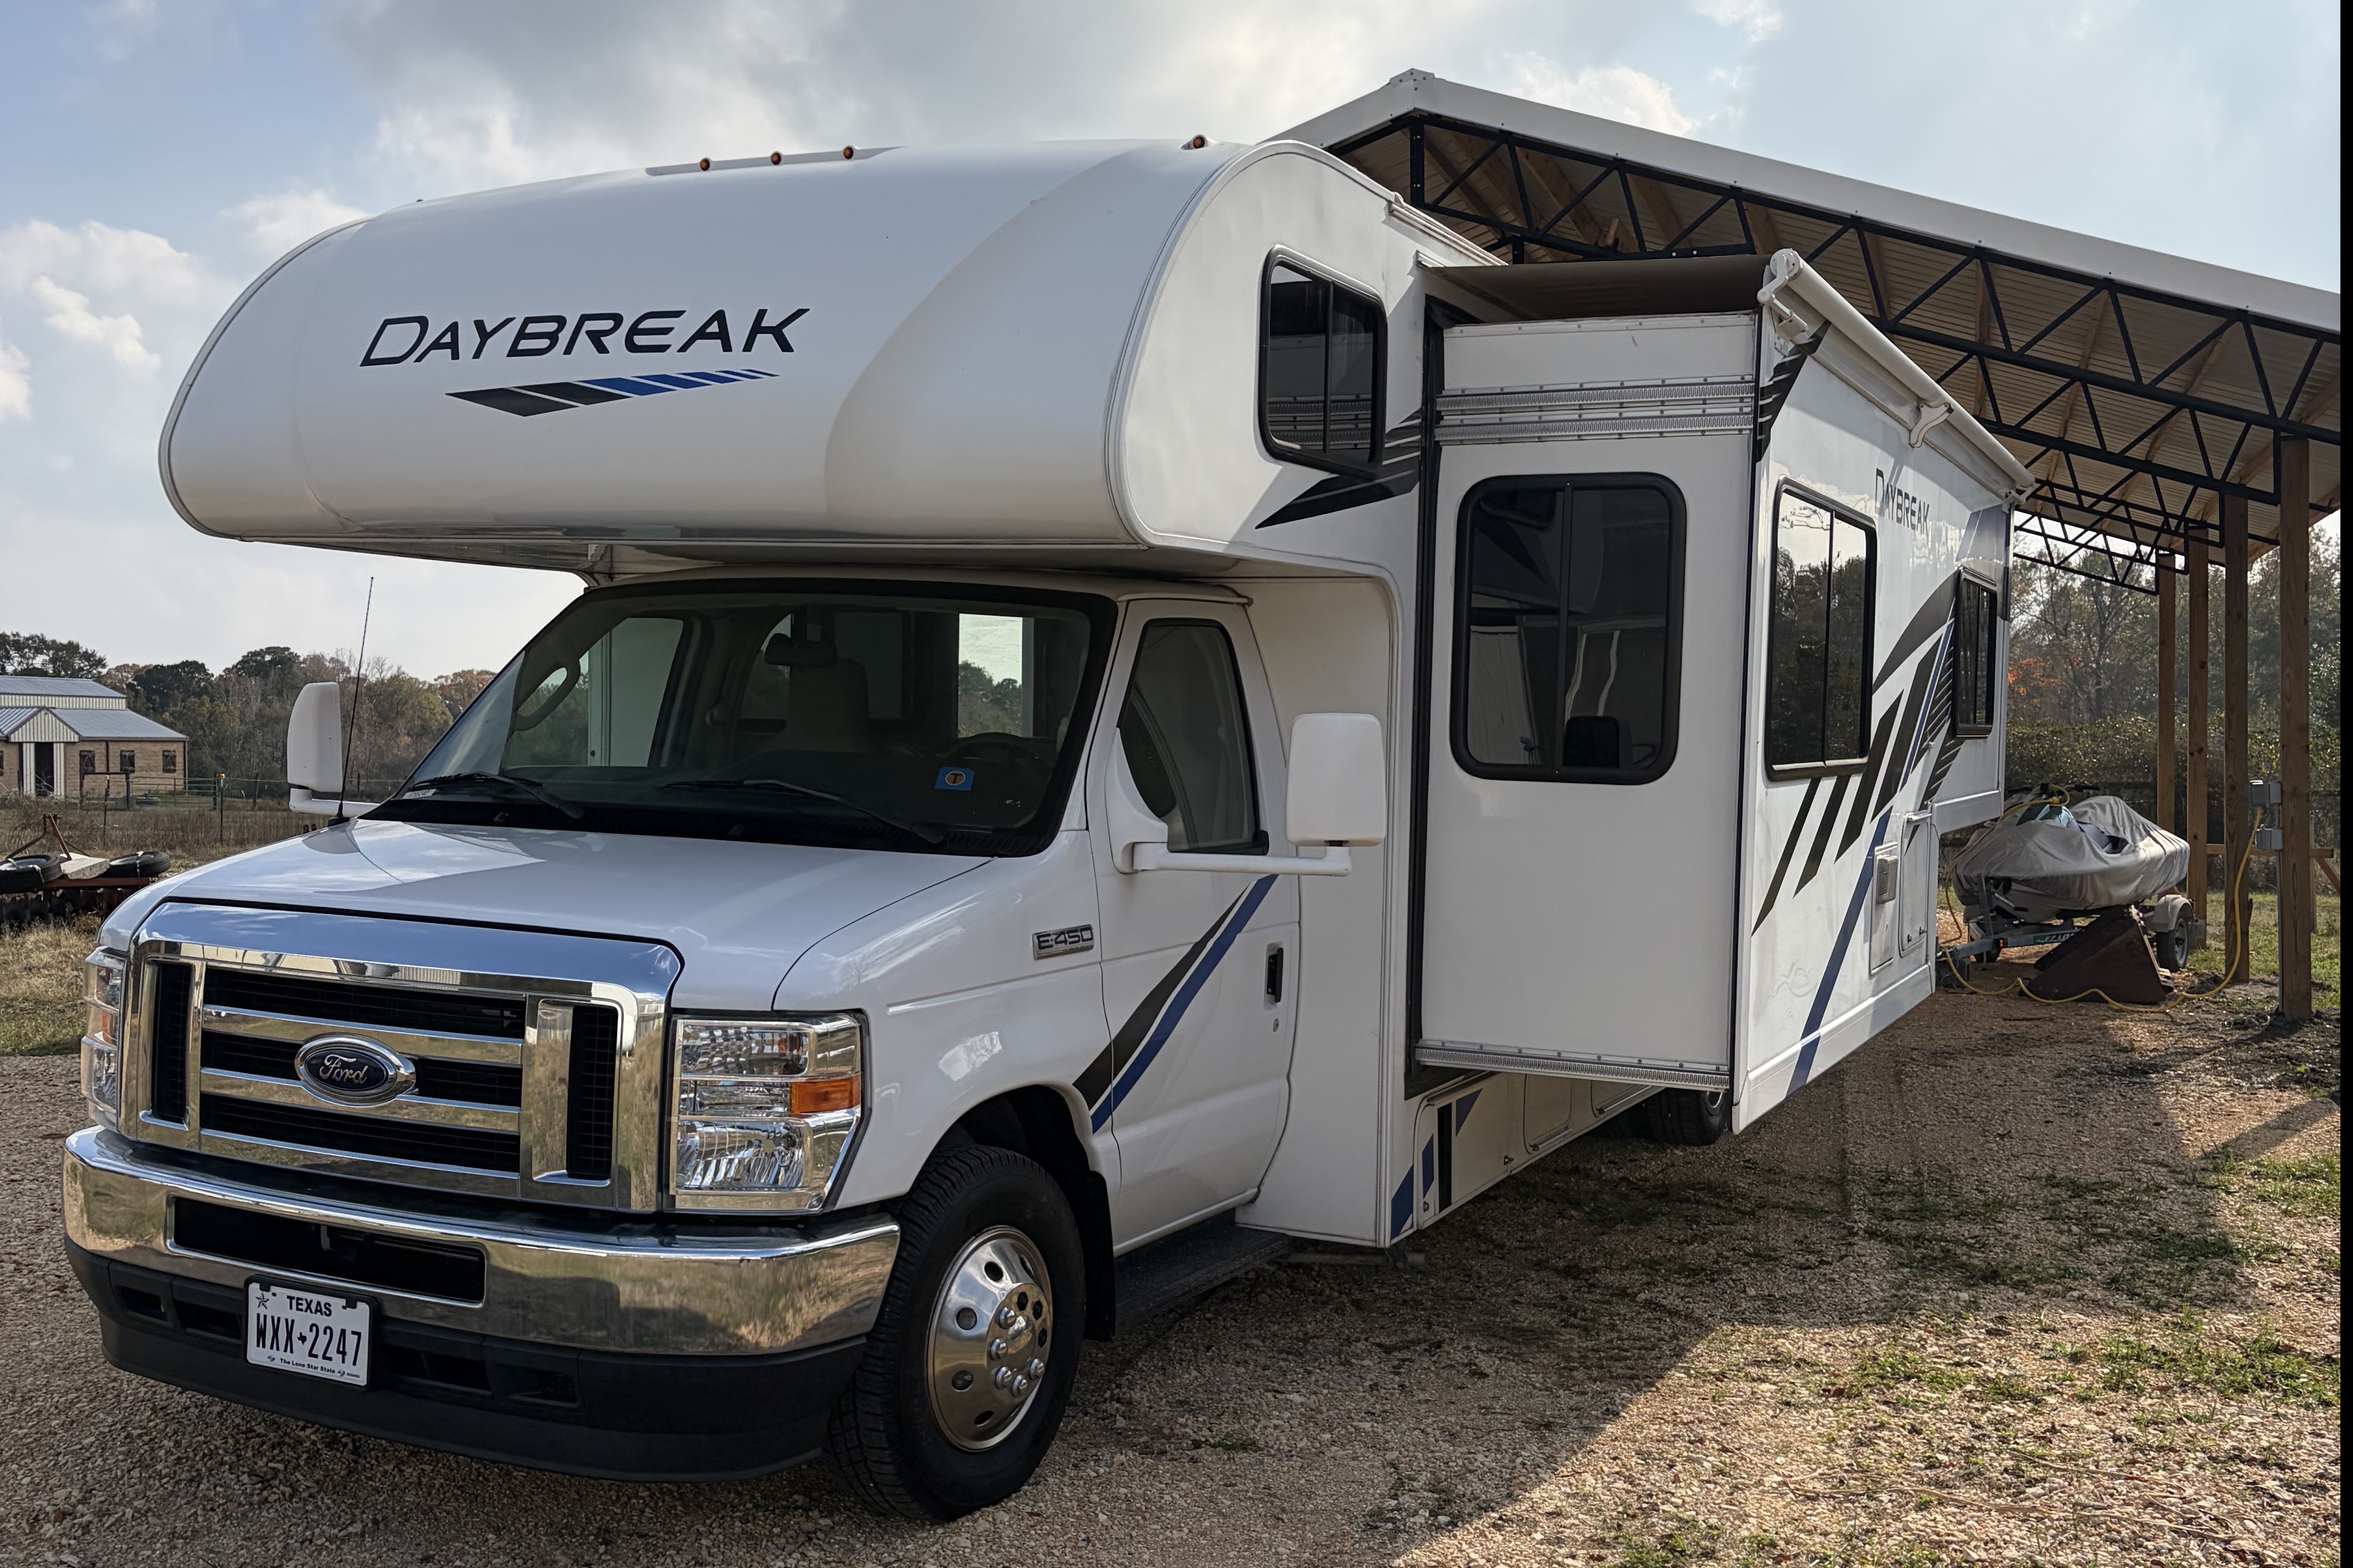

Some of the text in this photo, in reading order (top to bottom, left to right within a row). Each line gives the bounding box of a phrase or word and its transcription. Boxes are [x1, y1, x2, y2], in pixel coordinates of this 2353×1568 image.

[360, 308, 810, 367] DAYBREAK
[320, 1054, 368, 1084] Ford
[287, 1295, 332, 1317] TEXAS
[320, 1365, 335, 1374] State
